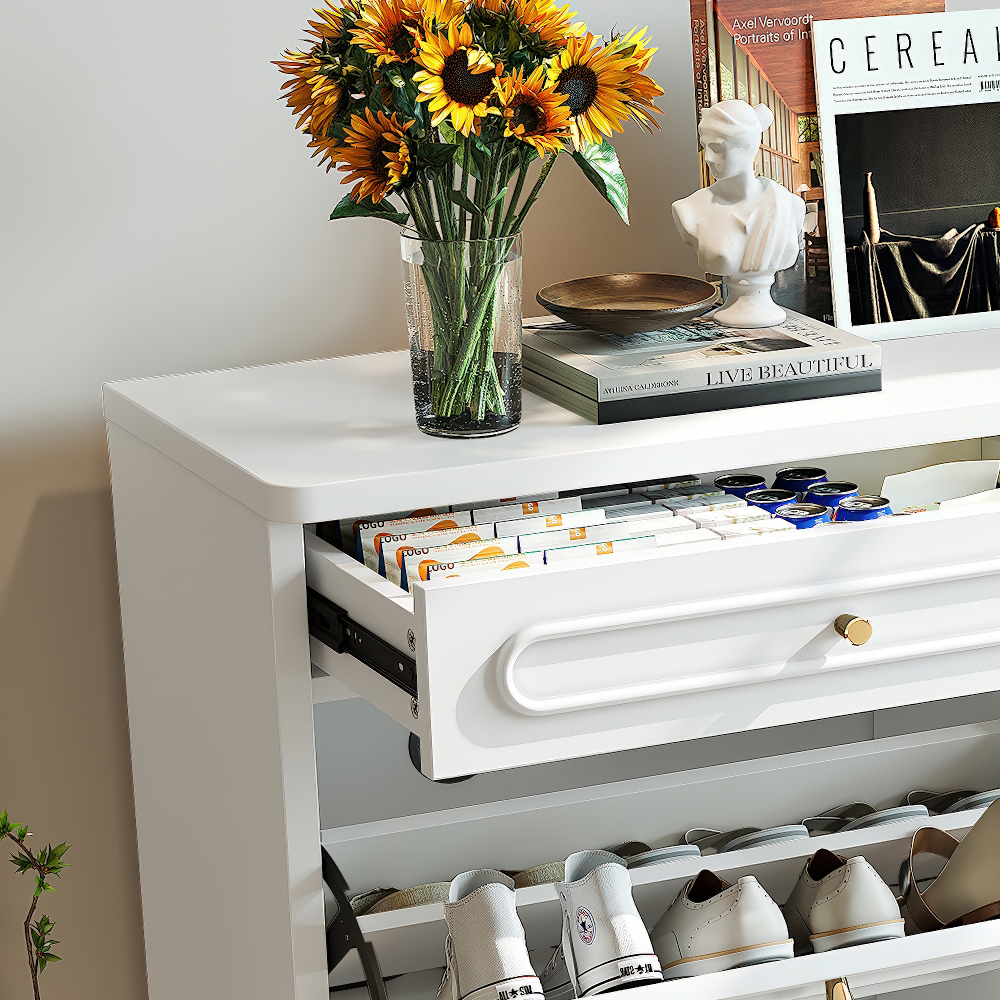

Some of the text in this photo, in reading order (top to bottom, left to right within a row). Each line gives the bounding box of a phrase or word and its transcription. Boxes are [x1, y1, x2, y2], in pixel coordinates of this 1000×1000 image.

[732, 14, 814, 30] Axel Vervoordt
[733, 31, 780, 45] Portraits
[783, 29, 794, 42] of
[706, 354, 873, 386] LIVE BEAUTIFUL
